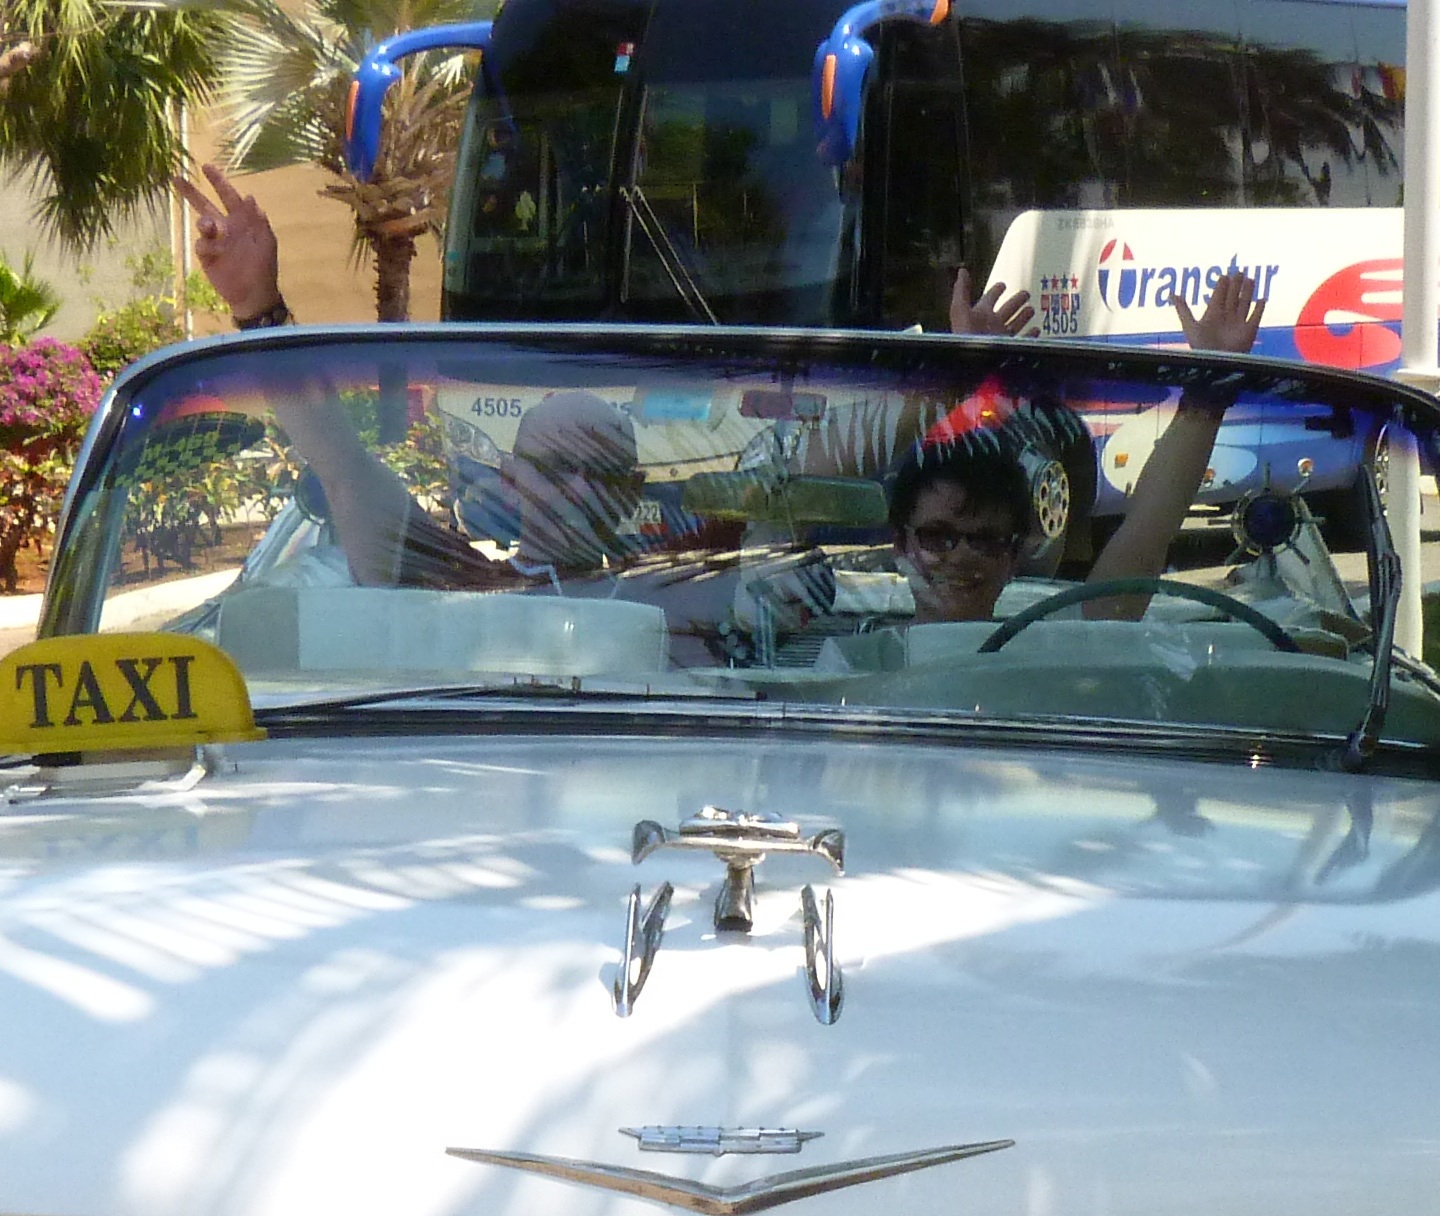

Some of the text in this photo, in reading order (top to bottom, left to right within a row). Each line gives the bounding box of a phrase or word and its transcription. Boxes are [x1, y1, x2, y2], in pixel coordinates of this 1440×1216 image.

[1042, 309, 1078, 335] 4505
[471, 397, 522, 417] 4505
[15, 655, 198, 728] TAXI
